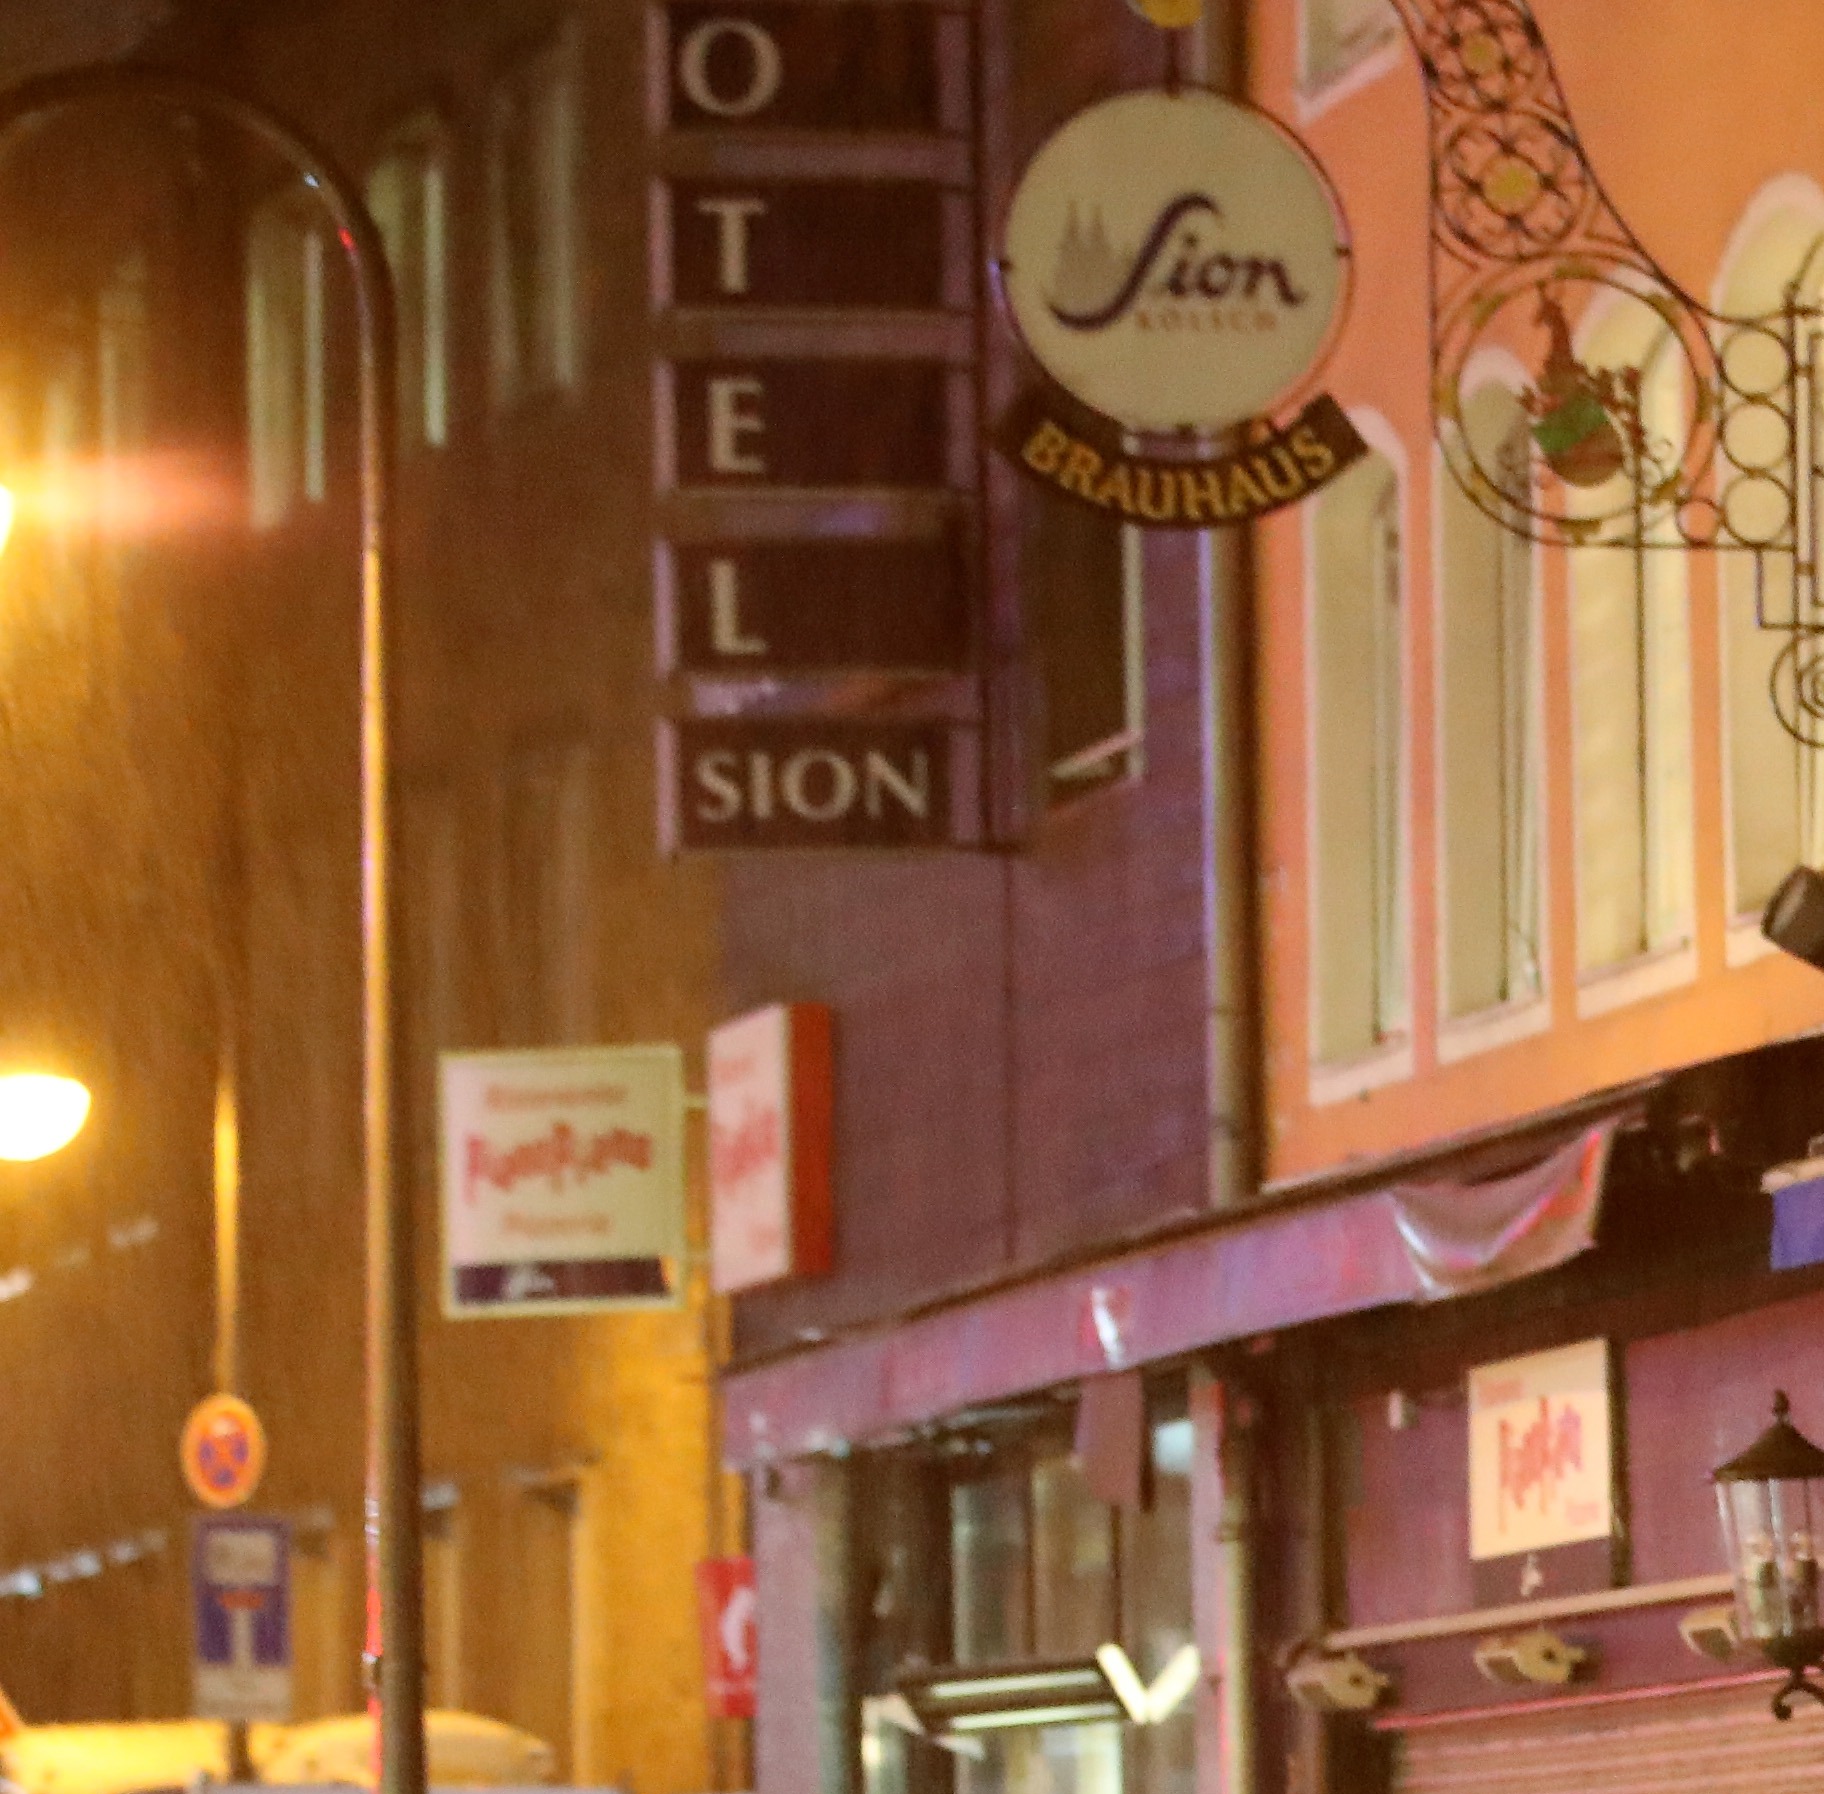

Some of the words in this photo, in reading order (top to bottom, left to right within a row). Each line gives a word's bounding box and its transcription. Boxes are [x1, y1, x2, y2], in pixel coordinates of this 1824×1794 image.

[1041, 192, 1310, 332] Sion
[1021, 418, 1335, 520] BRAUHAUS
[694, 748, 930, 822] SION
